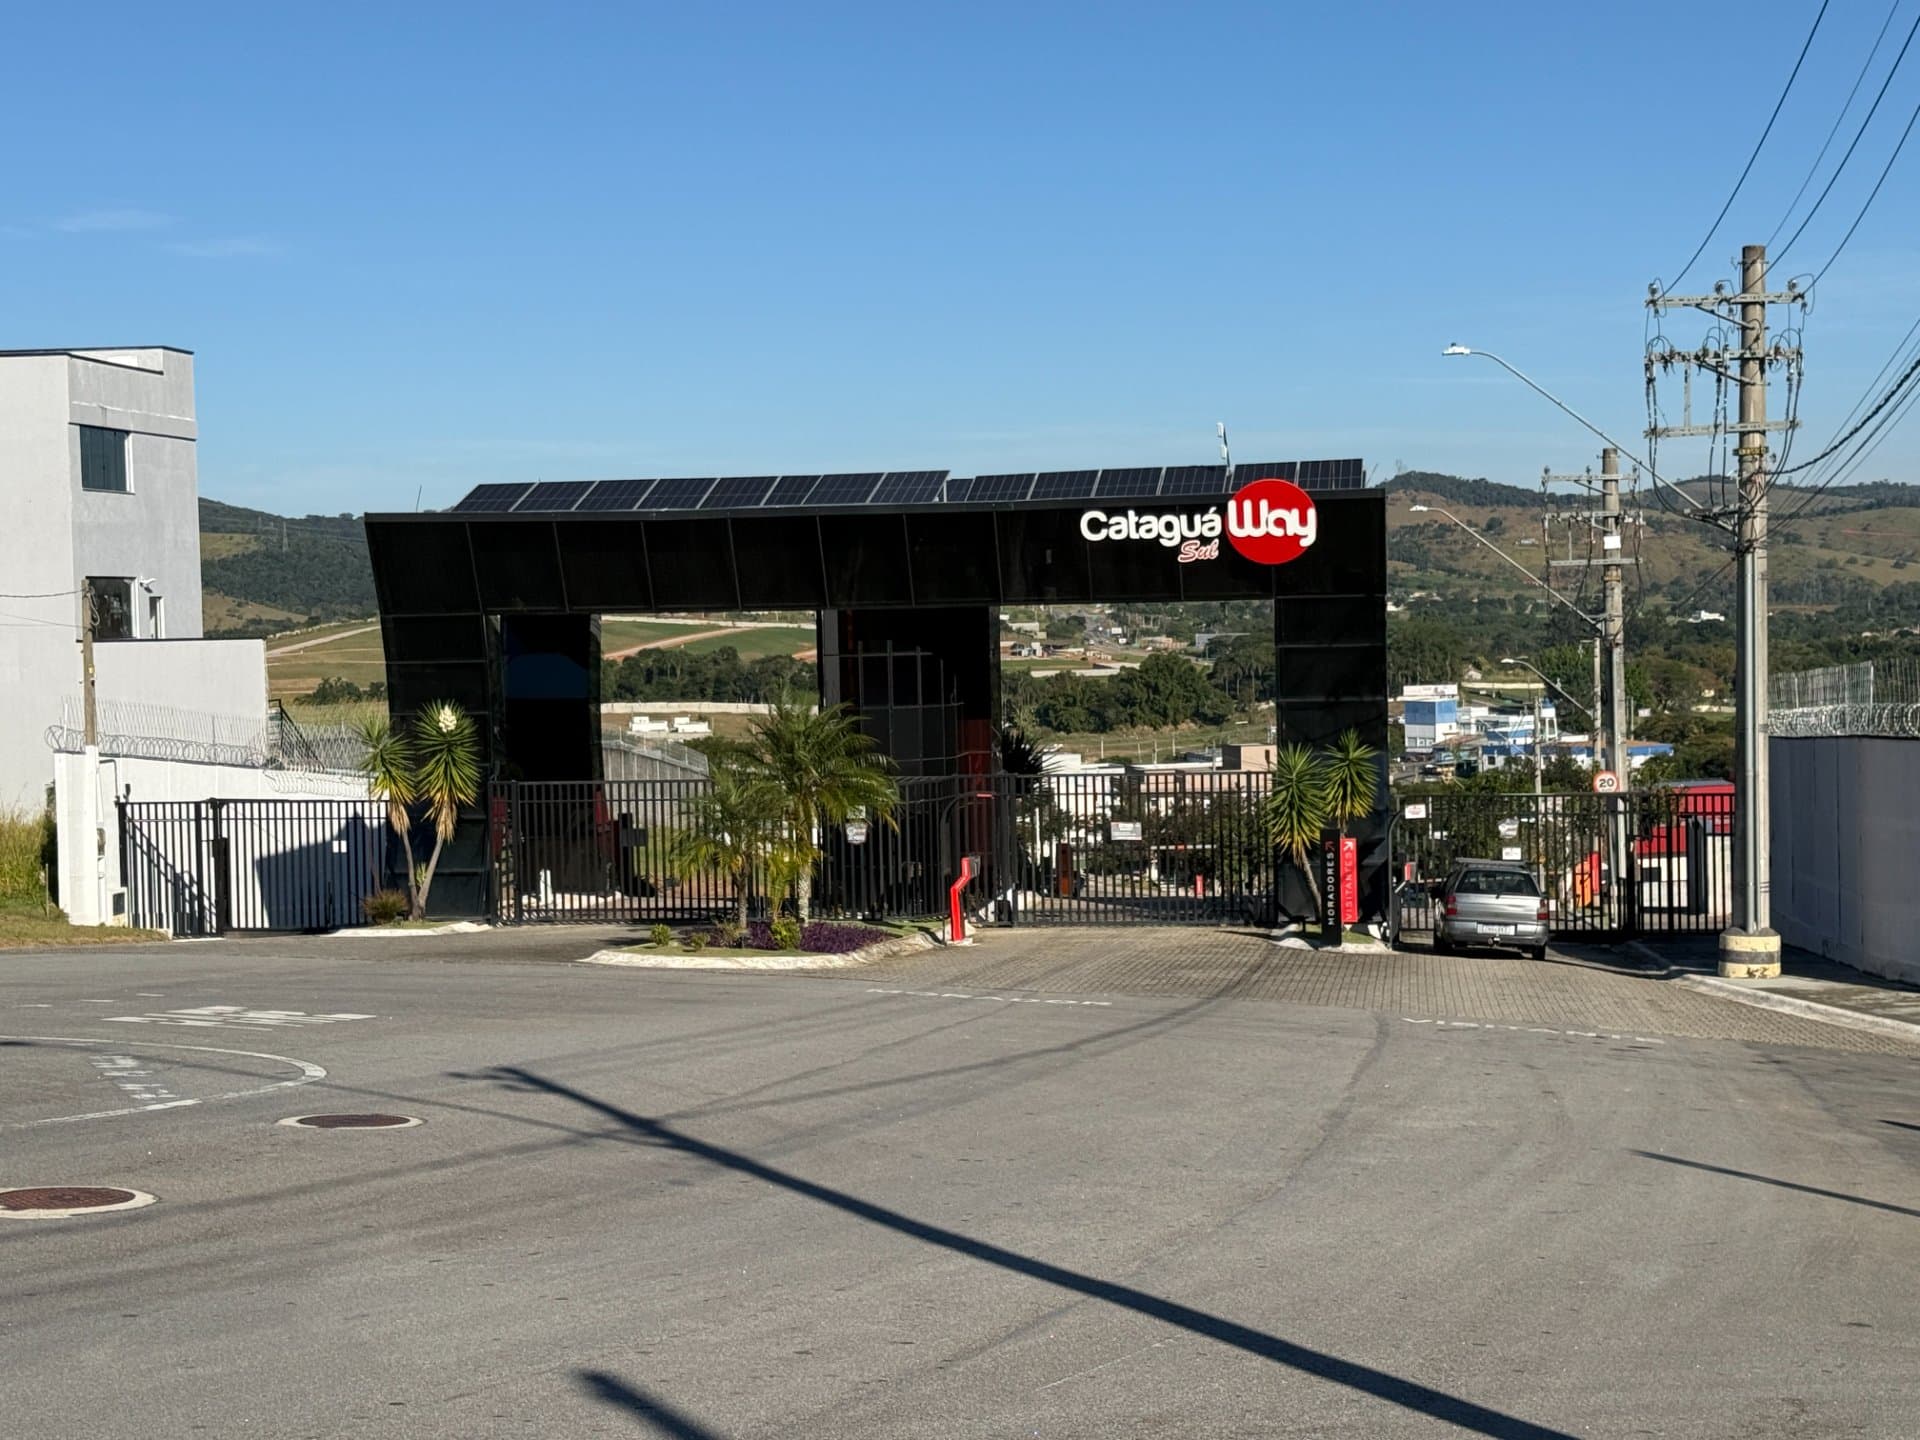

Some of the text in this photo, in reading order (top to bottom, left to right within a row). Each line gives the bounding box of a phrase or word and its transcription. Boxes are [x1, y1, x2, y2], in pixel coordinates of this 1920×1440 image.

[1080, 499, 1318, 547] Cataguá Way
[1177, 539, 1219, 563] Sul
[1599, 778, 1615, 788] 20
[1326, 852, 1335, 925] MORADORES
[1344, 852, 1353, 920] VISITANTES
